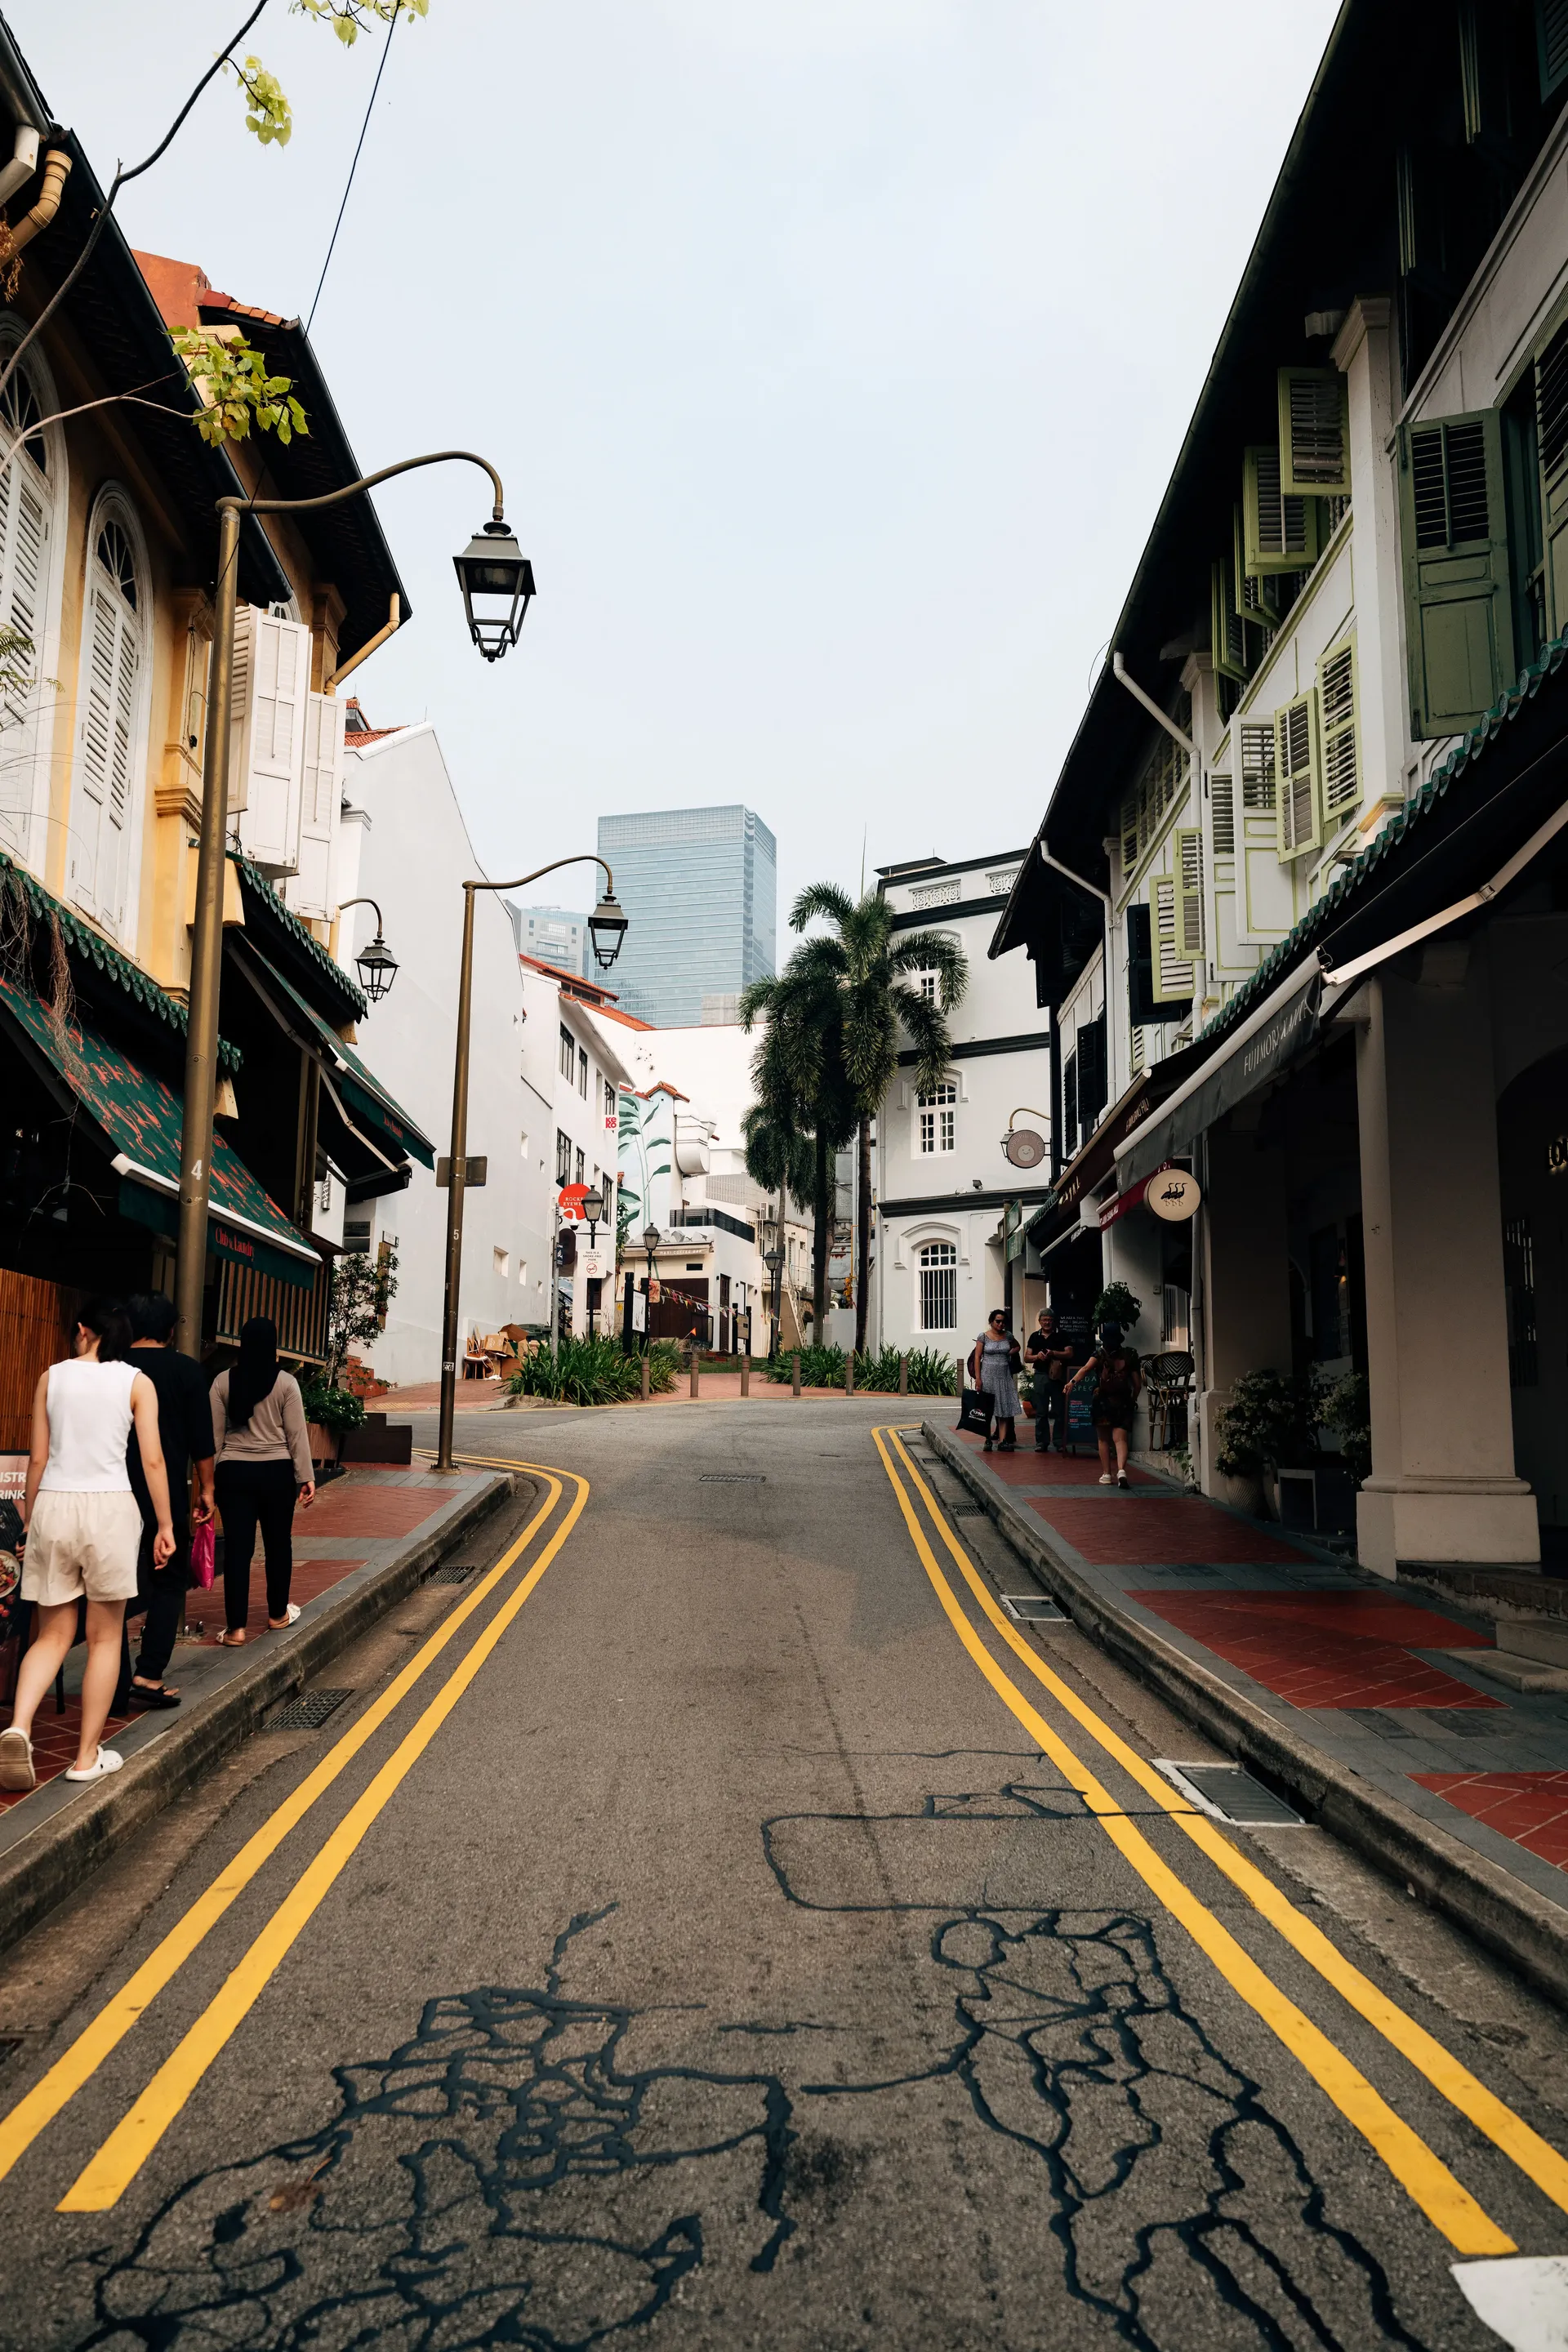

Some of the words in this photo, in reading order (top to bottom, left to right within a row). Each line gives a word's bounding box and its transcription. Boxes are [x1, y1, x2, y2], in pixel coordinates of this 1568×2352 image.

[191, 1160, 203, 1180] 4
[215, 1227, 228, 1247] Club
[453, 1229, 459, 1241] 5
